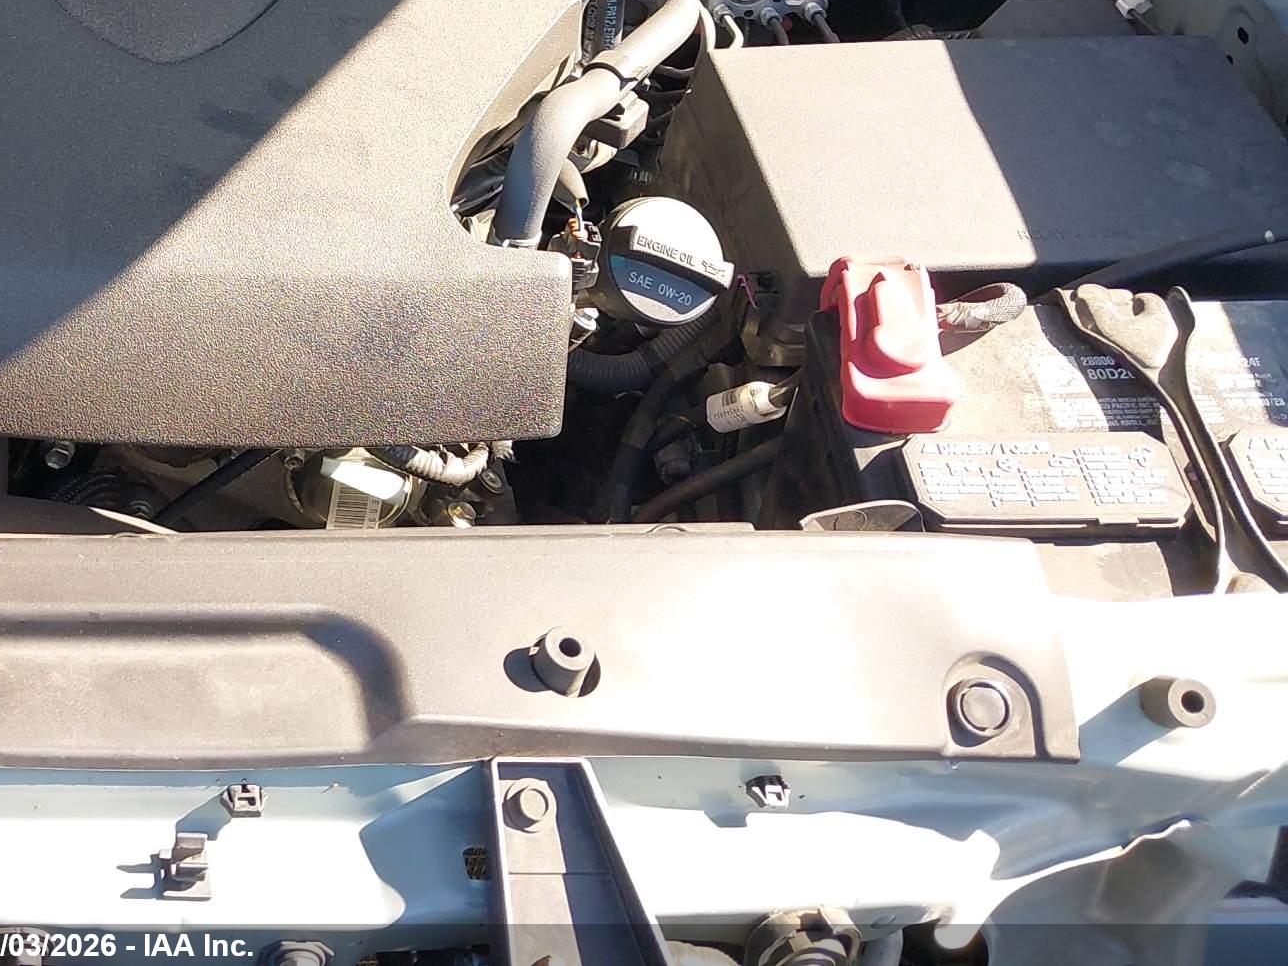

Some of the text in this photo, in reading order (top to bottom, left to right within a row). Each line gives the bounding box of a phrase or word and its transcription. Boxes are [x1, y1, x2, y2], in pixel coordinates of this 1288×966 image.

[636, 234, 696, 267] ENGINE OIL
[628, 270, 693, 307] SAE 0W-20
